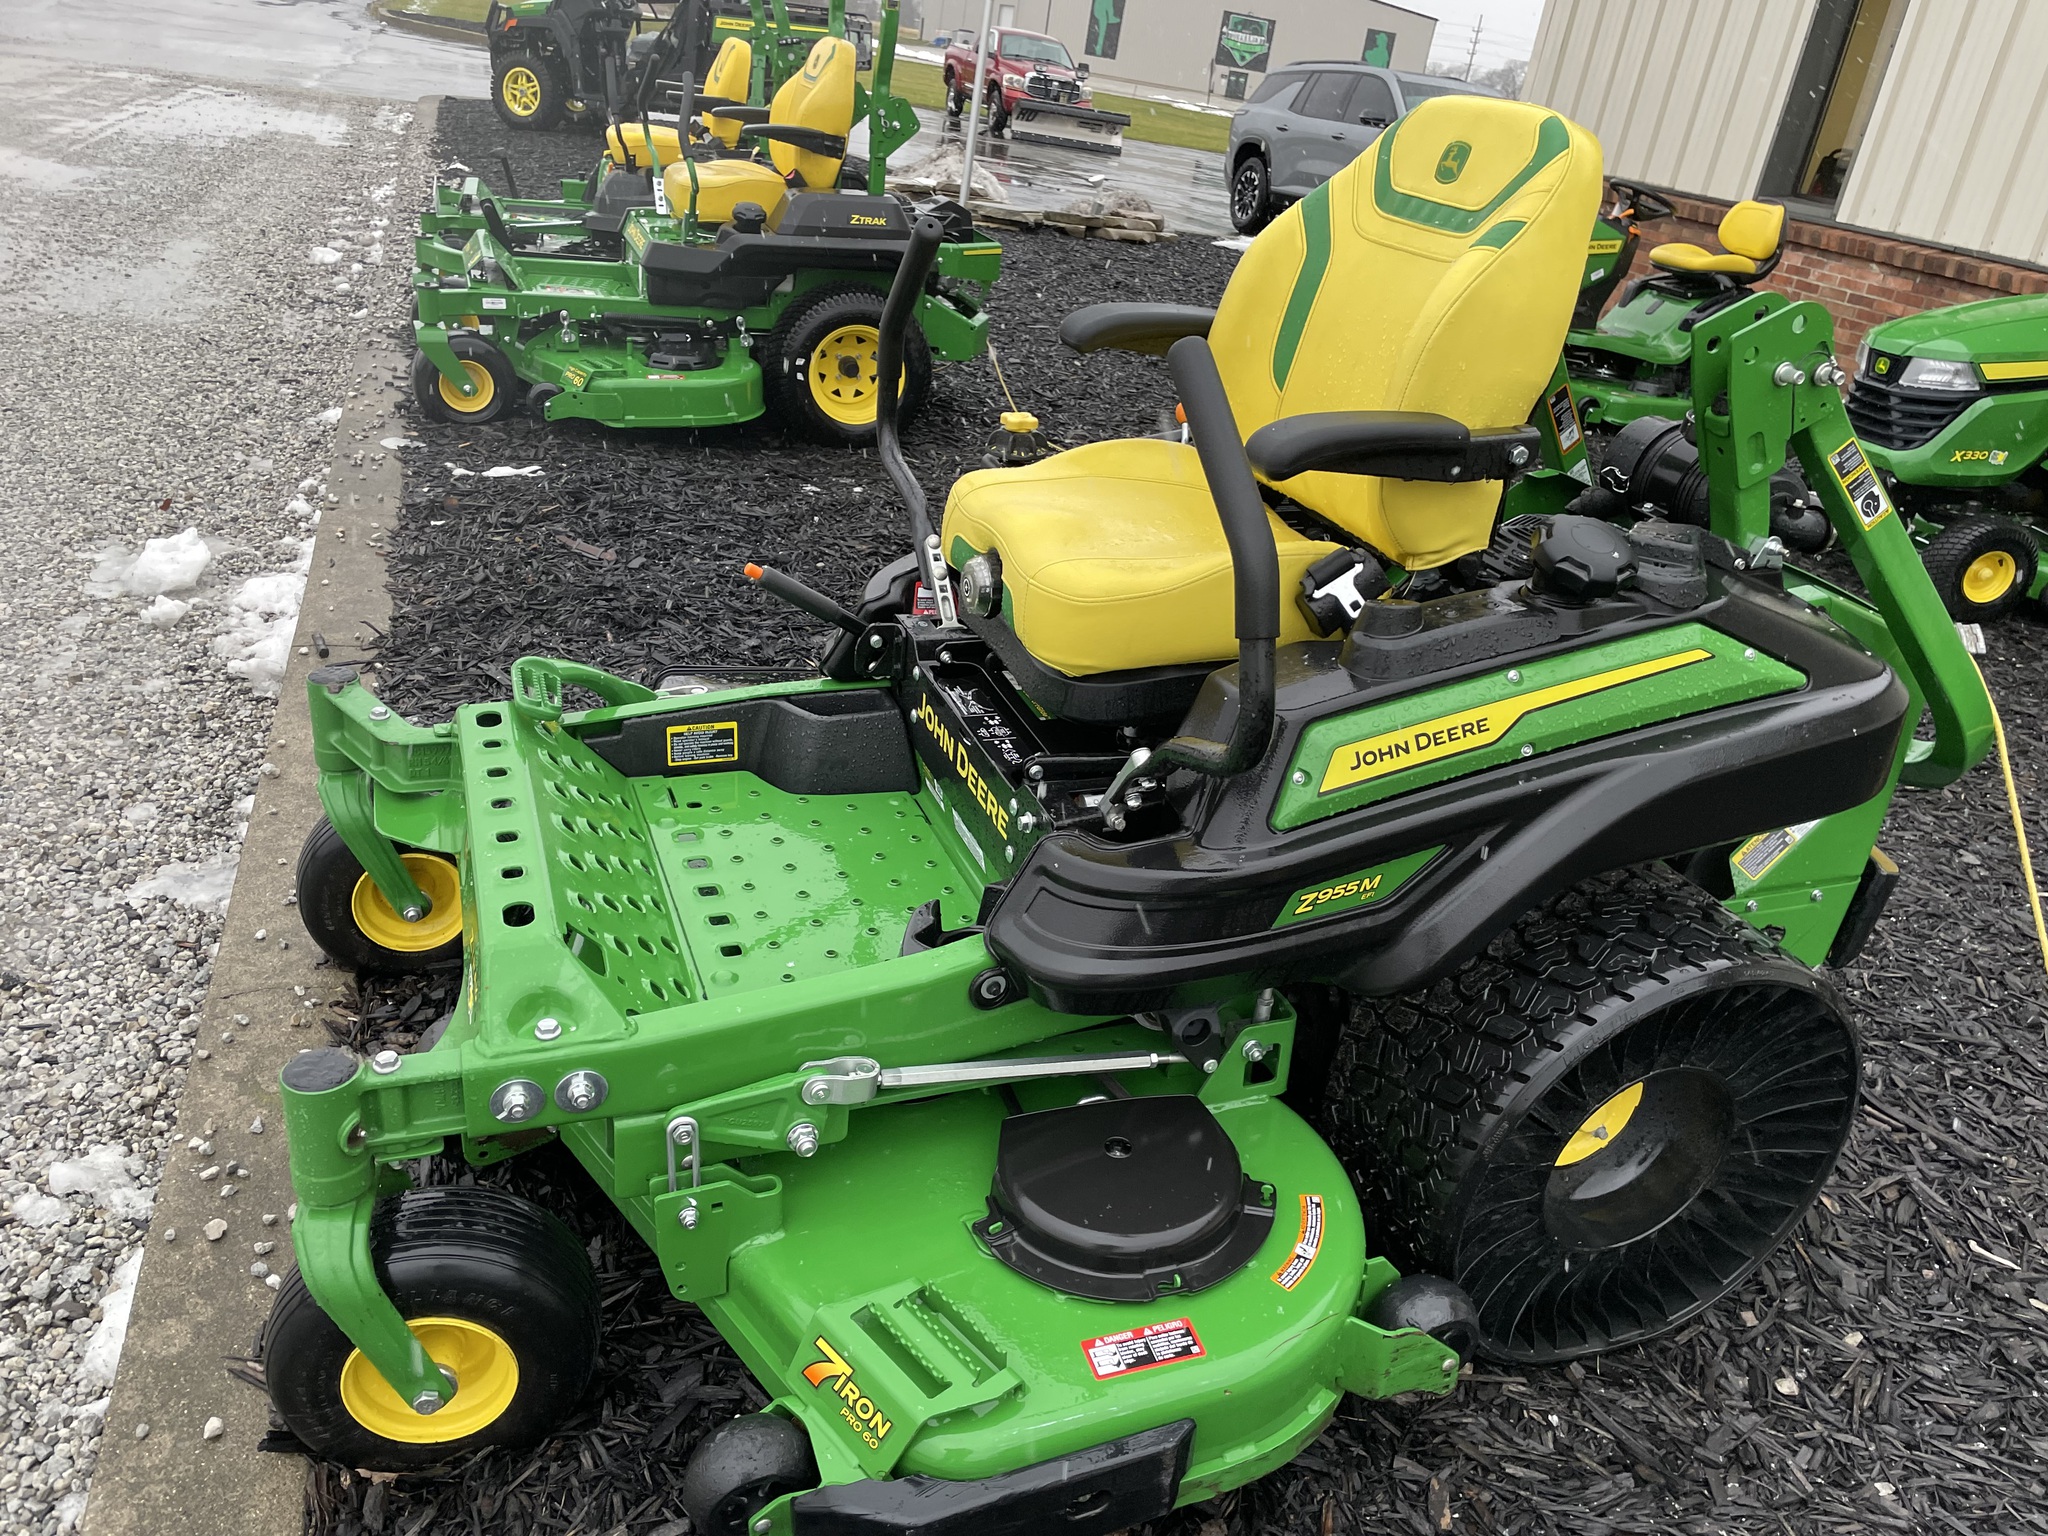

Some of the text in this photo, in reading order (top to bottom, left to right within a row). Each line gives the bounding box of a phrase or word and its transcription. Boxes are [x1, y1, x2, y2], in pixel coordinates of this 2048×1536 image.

[849, 214, 887, 226] ZTRAK
[573, 375, 584, 387] 60
[1949, 449, 1989, 463] X330
[1350, 717, 1491, 771] JOHN DEERE
[916, 692, 955, 762] JOHN
[955, 740, 1009, 841] DEERE
[1293, 873, 1383, 916] Z955M
[1360, 891, 1376, 901] EFI
[1152, 1320, 1183, 1333] PELIGRO
[1103, 1331, 1134, 1345] DANGER
[839, 1406, 879, 1450] PRO 60
